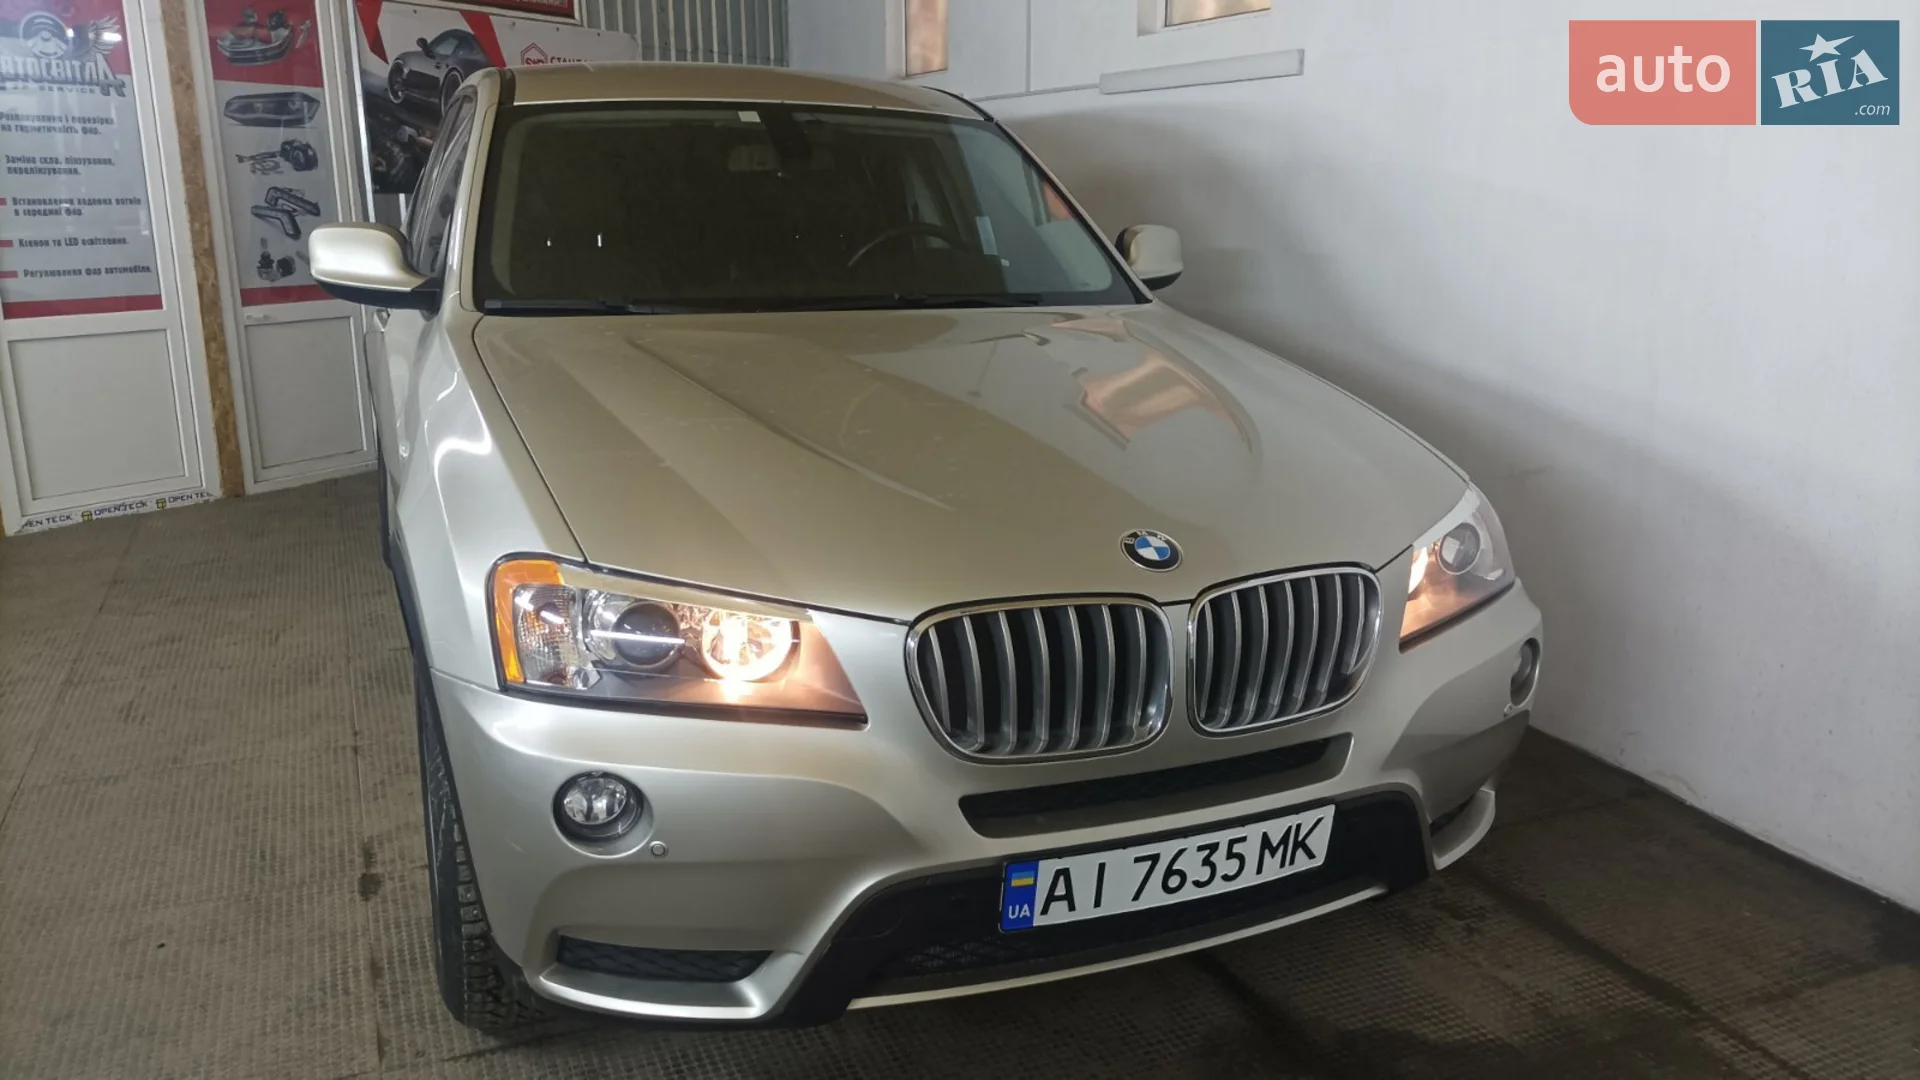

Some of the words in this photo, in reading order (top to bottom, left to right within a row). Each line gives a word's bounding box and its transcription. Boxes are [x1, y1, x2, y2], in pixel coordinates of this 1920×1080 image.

[65, 237, 79, 247] LED
[1130, 834, 1248, 903] 7635
[1255, 815, 1325, 876] MK
[1007, 903, 1031, 920] UA
